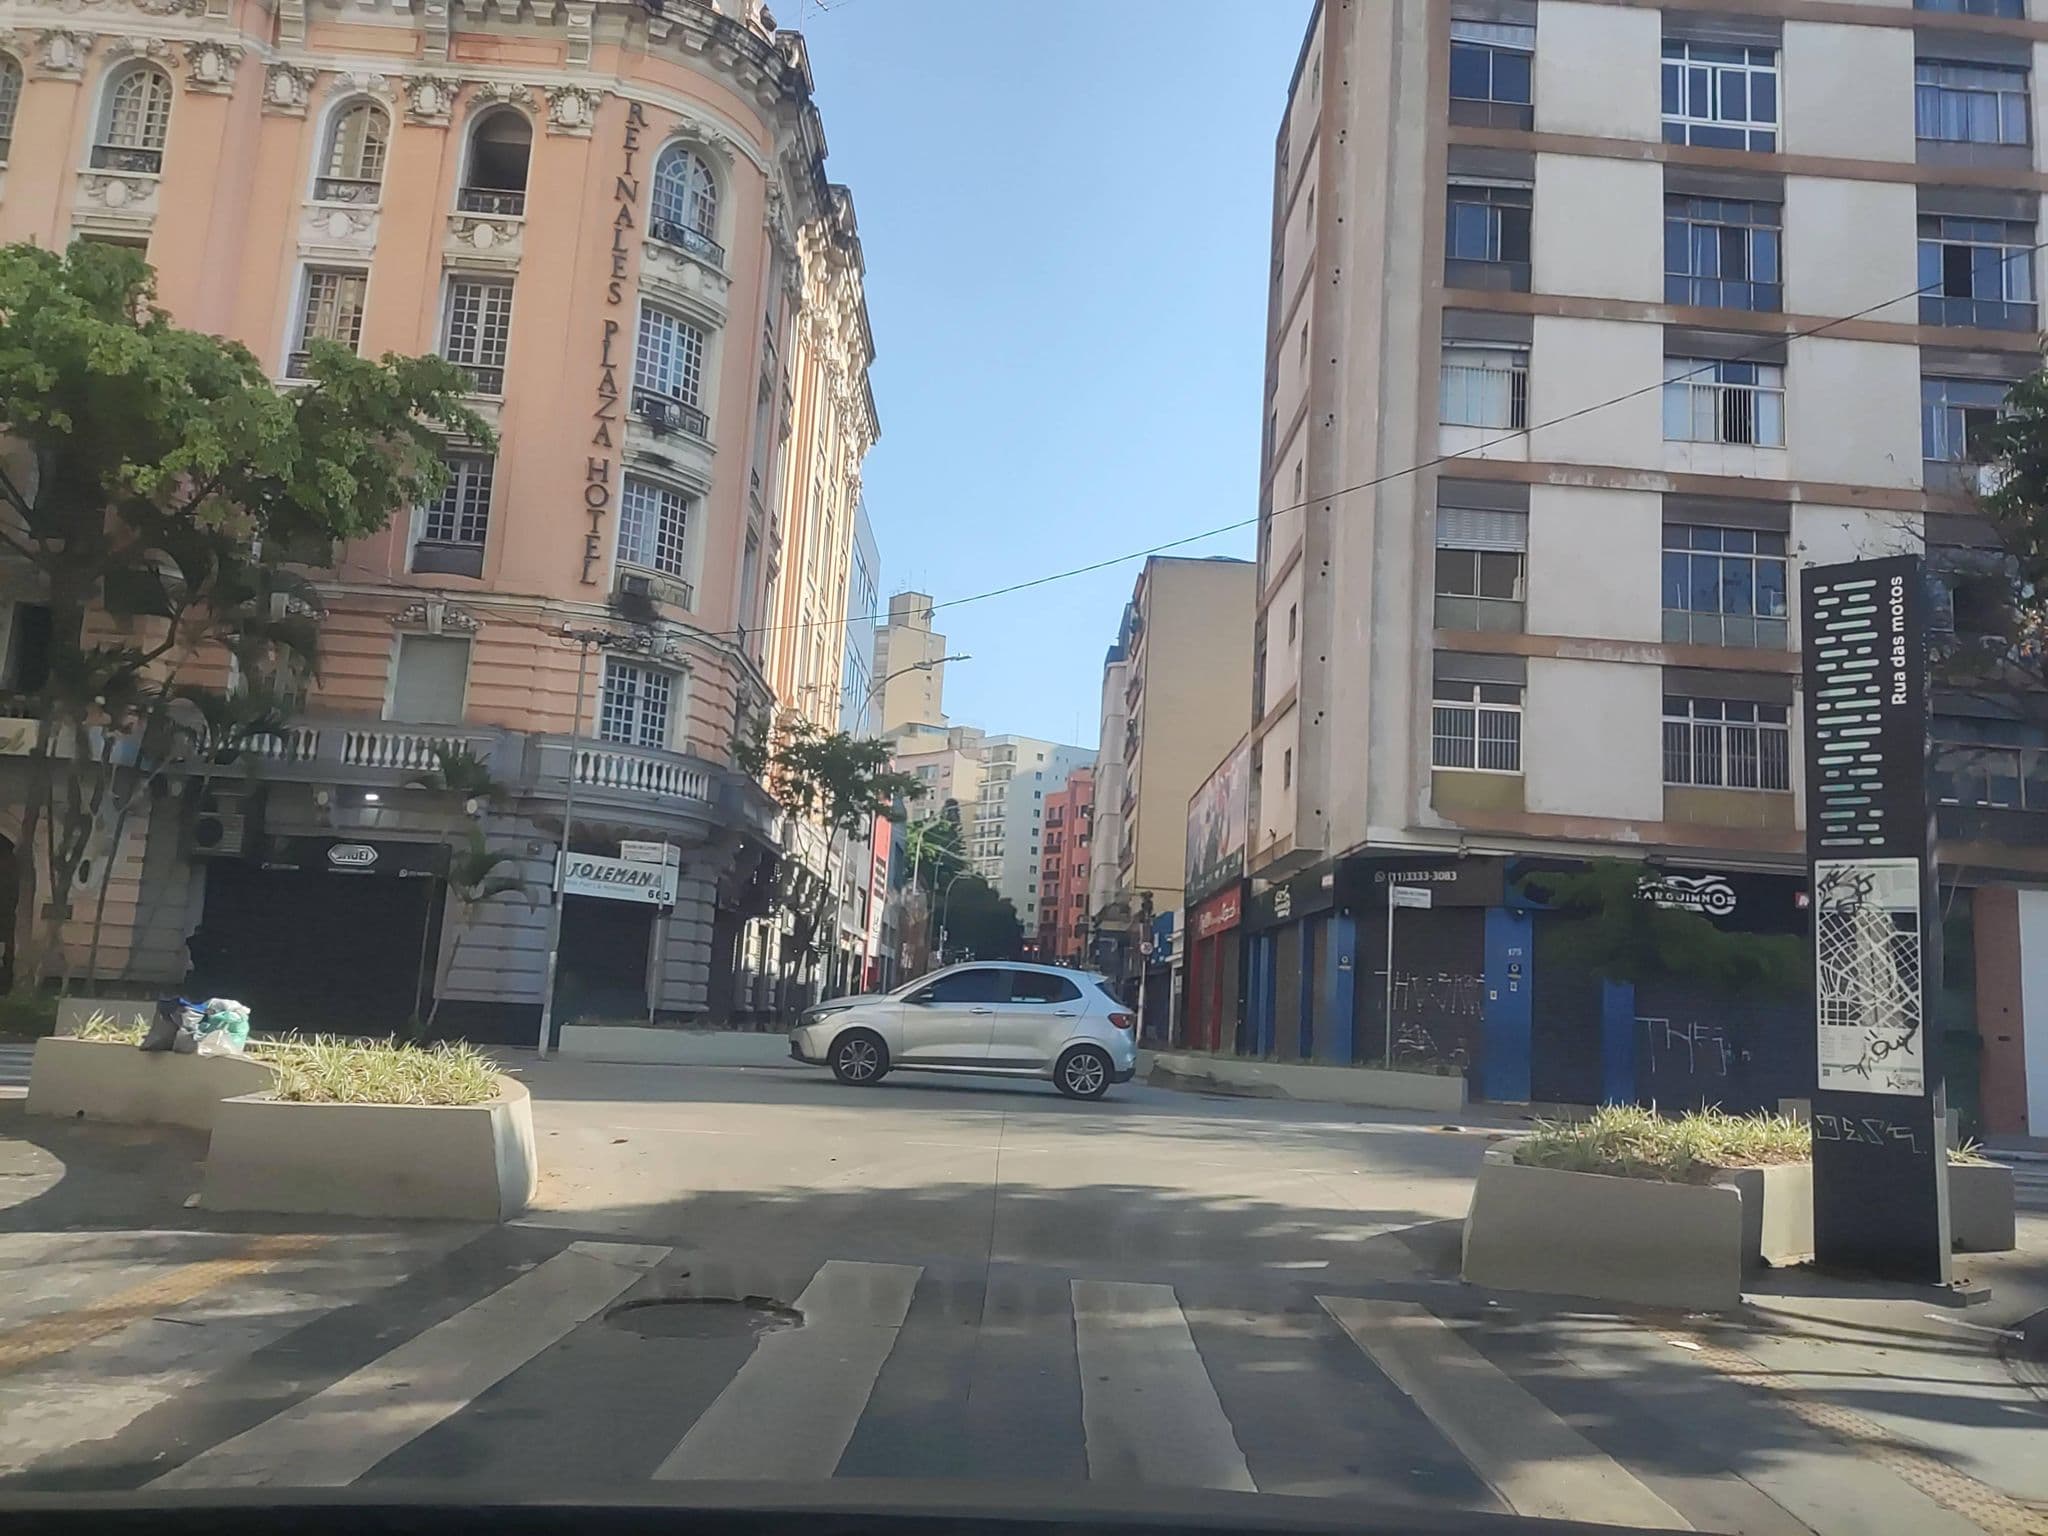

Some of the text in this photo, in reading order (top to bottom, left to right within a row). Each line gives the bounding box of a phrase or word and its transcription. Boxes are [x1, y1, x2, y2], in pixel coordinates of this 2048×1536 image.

[580, 102, 648, 586] REINALES PLAZA HOTEL
[1889, 576, 1907, 705] Rua das motos
